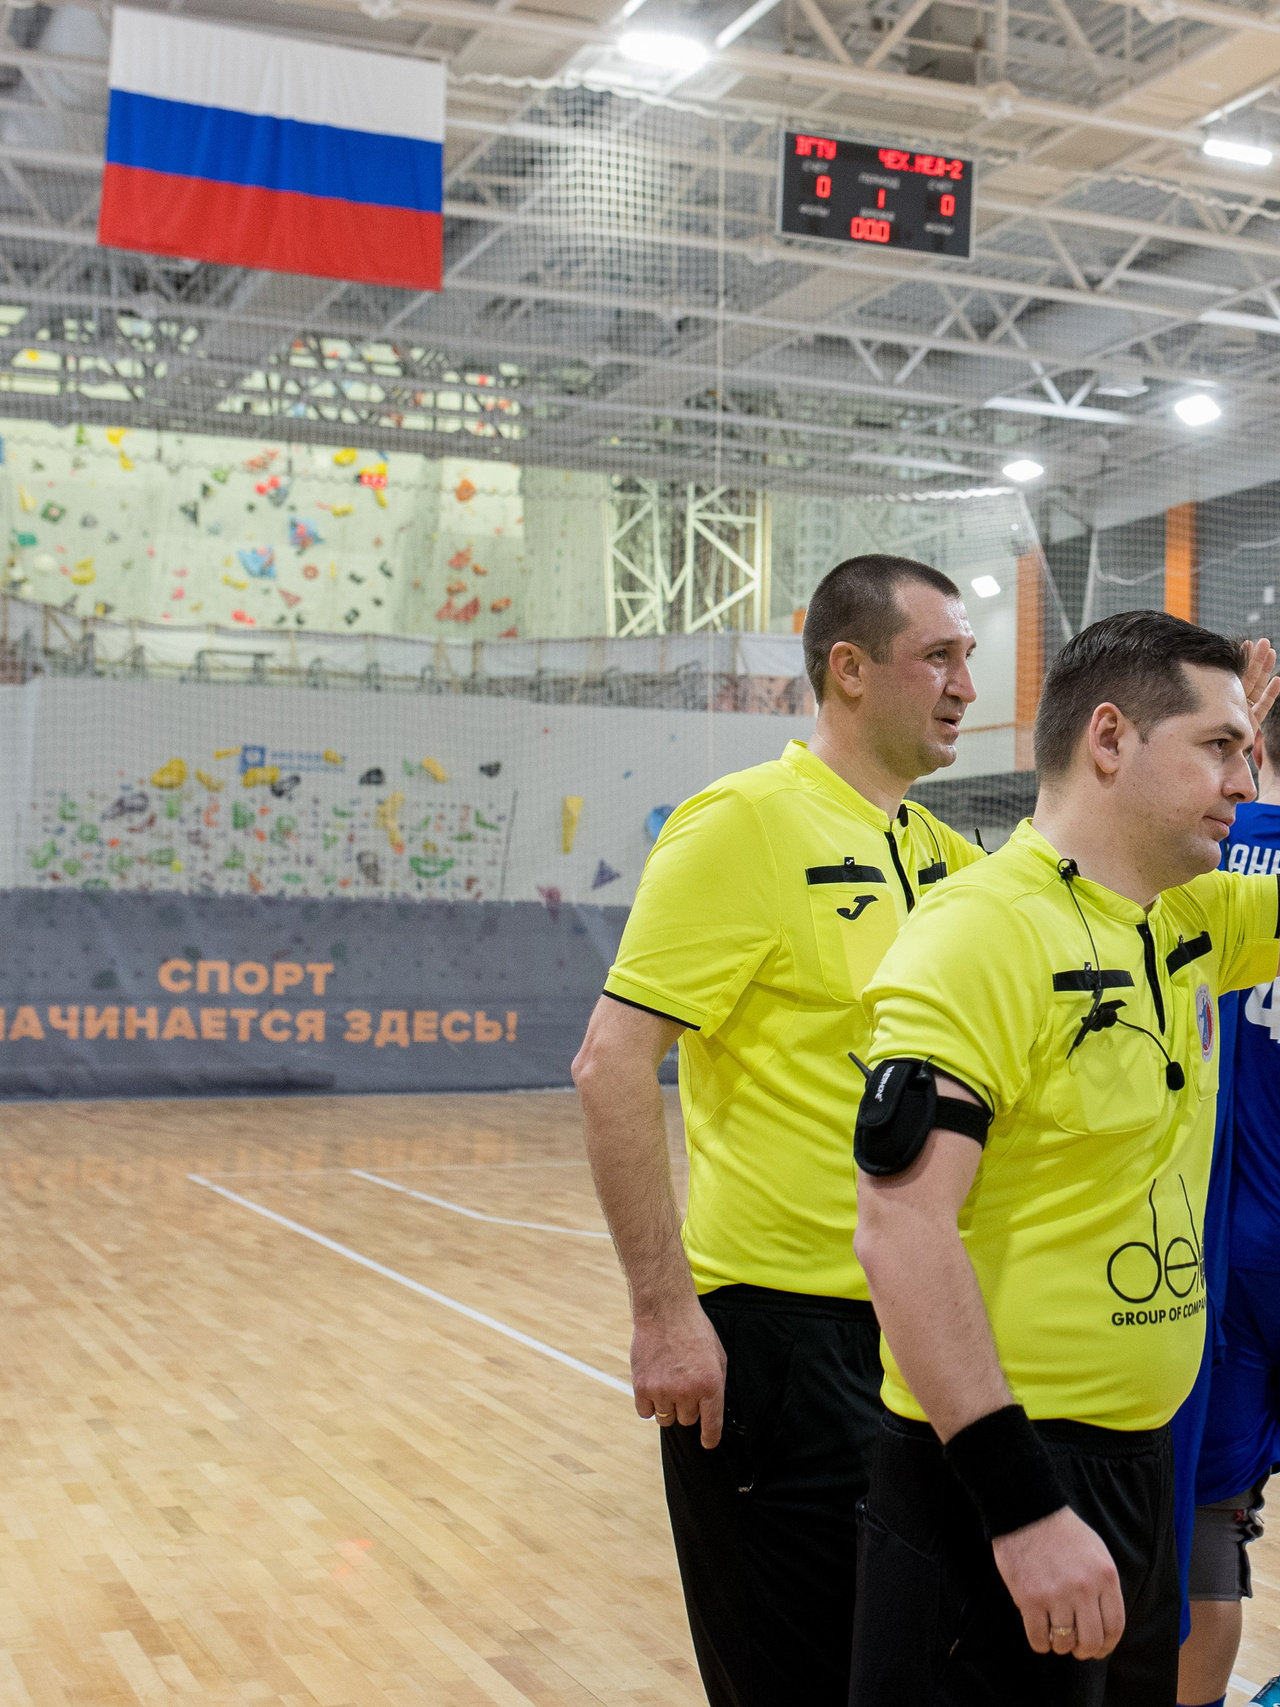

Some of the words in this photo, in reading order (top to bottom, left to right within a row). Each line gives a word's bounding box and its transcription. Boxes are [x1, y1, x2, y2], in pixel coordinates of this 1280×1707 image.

[816, 175, 832, 198] 0
[940, 194, 956, 217] 0
[158, 958, 334, 995] СПОРТ
[344, 1010, 519, 1048] ЗДЕСЬ!
[1111, 1308, 1167, 1326] GROUP
[1169, 1306, 1182, 1321] OF
